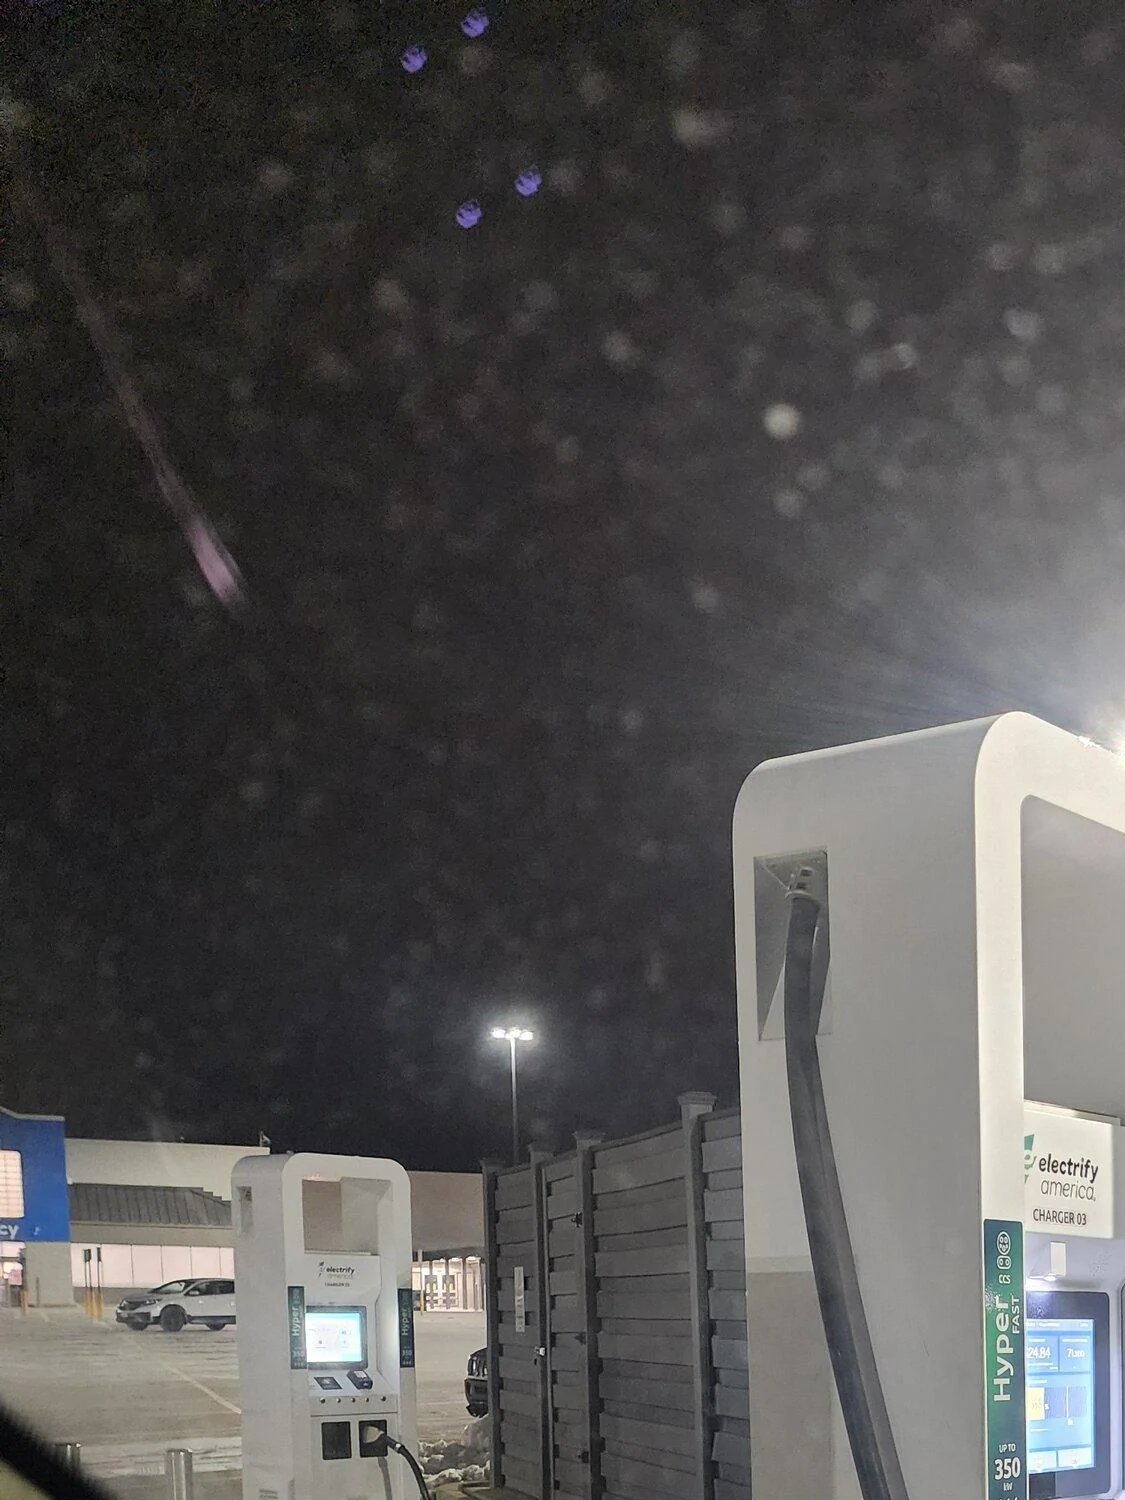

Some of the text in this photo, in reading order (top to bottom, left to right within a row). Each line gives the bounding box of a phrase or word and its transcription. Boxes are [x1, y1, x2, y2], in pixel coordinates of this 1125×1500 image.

[1039, 1153, 1098, 1183] electrify
[1033, 1208, 1087, 1225] CHARGER 03
[998, 1274, 1011, 1284] CCS
[292, 1305, 301, 1336] Hyper
[1012, 1296, 1020, 1334] FAST
[994, 1294, 1014, 1401] Hyper
[999, 1443, 1016, 1453] UP TO
[994, 1457, 1021, 1480] 350
